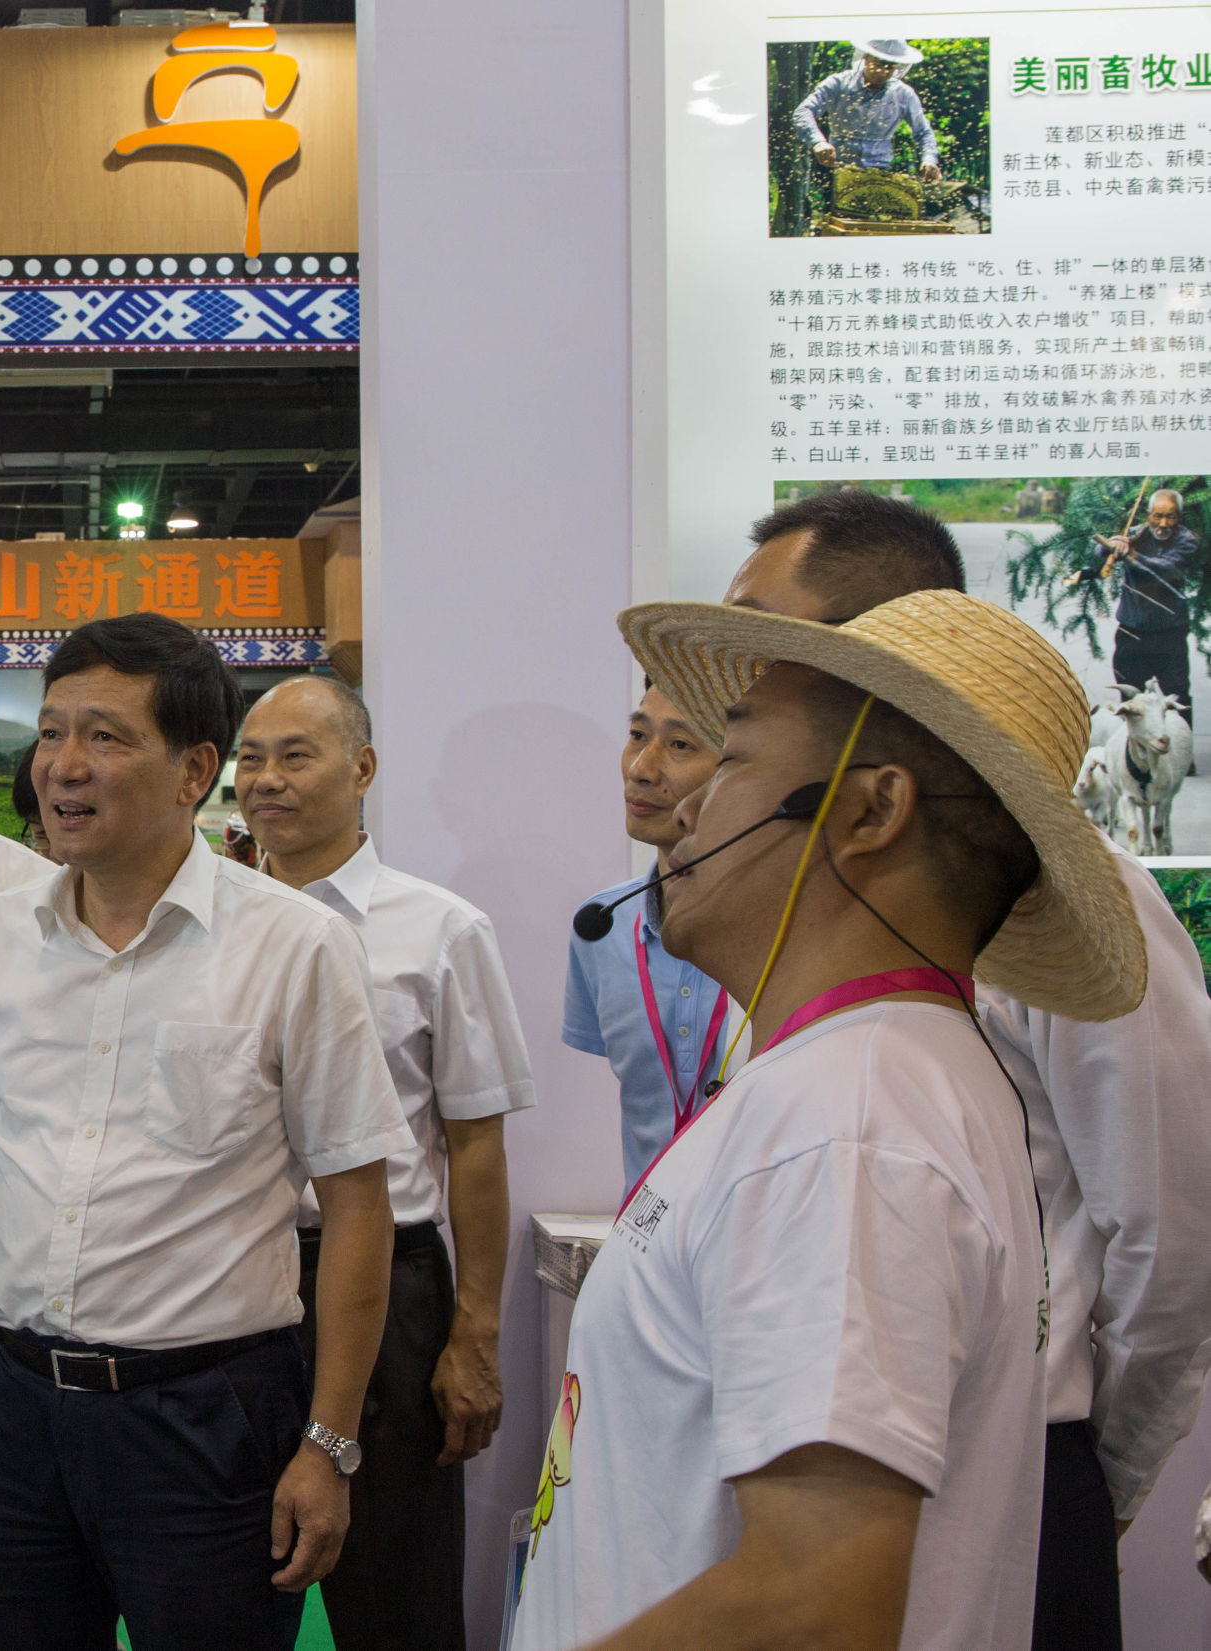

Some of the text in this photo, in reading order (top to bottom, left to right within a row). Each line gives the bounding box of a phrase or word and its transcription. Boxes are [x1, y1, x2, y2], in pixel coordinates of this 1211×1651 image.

[1013, 53, 1211, 92] 美丽畜牧业
[1045, 122, 1211, 144] 莲都区积极推进“
[1003, 148, 1211, 172] 新主体、新业态、新模
[1003, 176, 1211, 198] 示范县、中央畜禽粪污
[808, 255, 1211, 280] 养猪上楼：将传统“吃、住、排”一体的单层猪
[778, 309, 1211, 332] “十箱万元养蜂模式助低收入农户增收”项目，帮助
